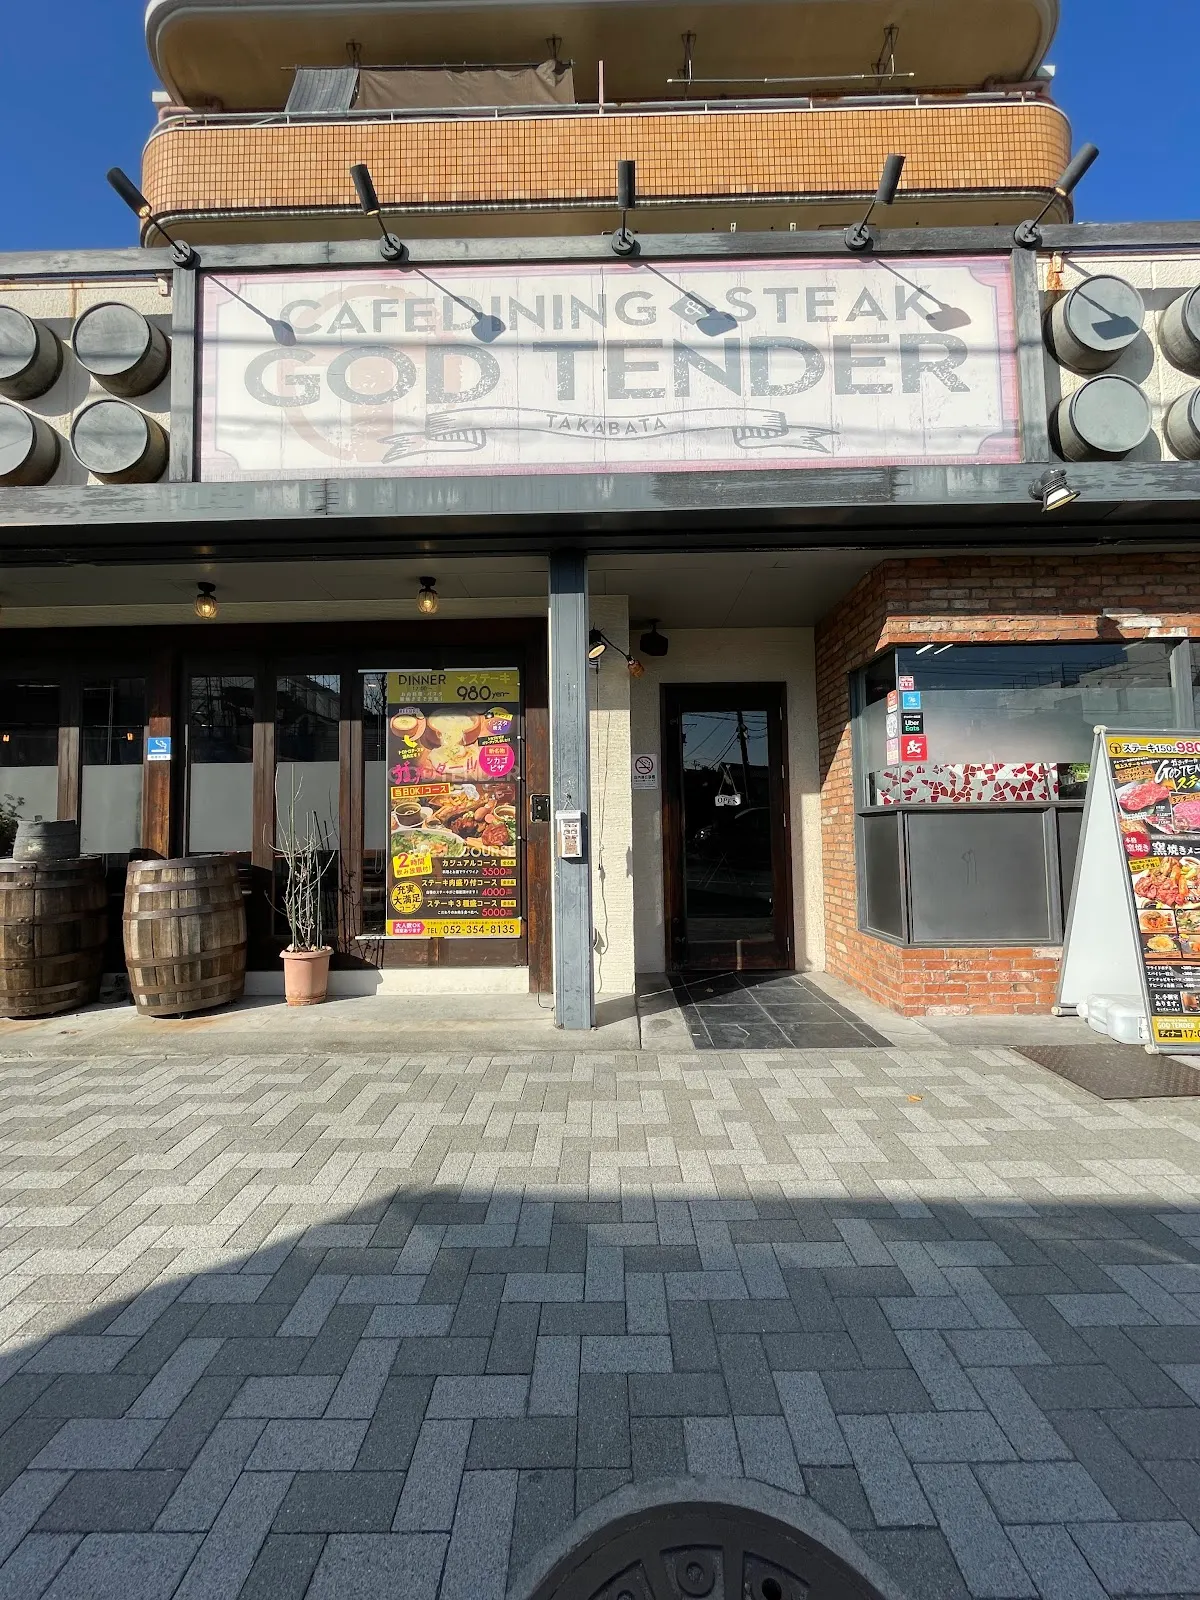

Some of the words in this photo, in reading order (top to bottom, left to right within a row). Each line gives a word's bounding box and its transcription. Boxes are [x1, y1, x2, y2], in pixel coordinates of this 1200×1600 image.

[684, 299, 698, 315] &
[725, 283, 933, 324] STEAK
[244, 344, 500, 408] GOD
[532, 333, 971, 401] TENDER
[546, 414, 668, 437] TAKABATA
[398, 674, 446, 686] DINNER
[469, 673, 511, 684] ステーキ
[487, 757, 508, 765] シカゴ
[490, 764, 505, 772] ピザ
[442, 859, 497, 867] カジュアルコース
[396, 884, 415, 895] 充実
[393, 894, 421, 905] 大満足
[399, 904, 418, 912] コース
[443, 925, 515, 934] 052-354-8135
